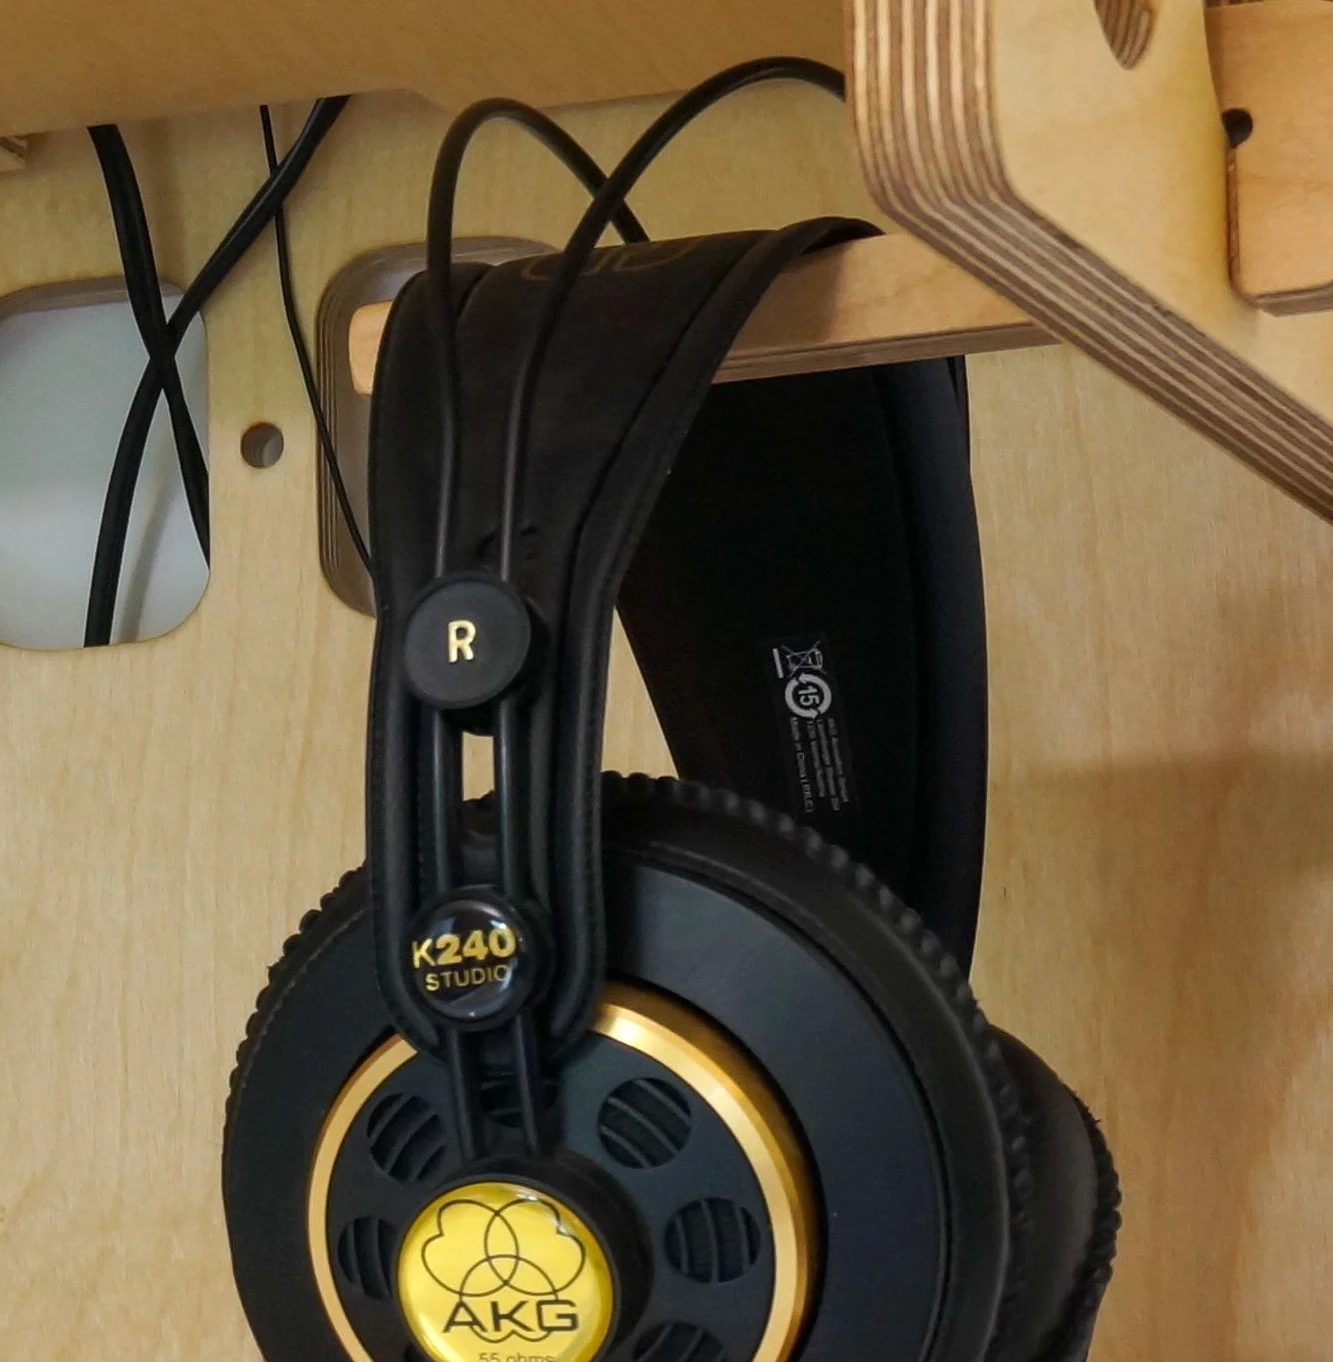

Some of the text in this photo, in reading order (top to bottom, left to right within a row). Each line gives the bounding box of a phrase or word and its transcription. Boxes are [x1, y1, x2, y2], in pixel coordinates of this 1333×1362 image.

[447, 619, 476, 663] R
[797, 685, 820, 706] 15
[411, 927, 517, 969] K240
[425, 964, 512, 991] STUDIO
[442, 1299, 579, 1334] AKG
